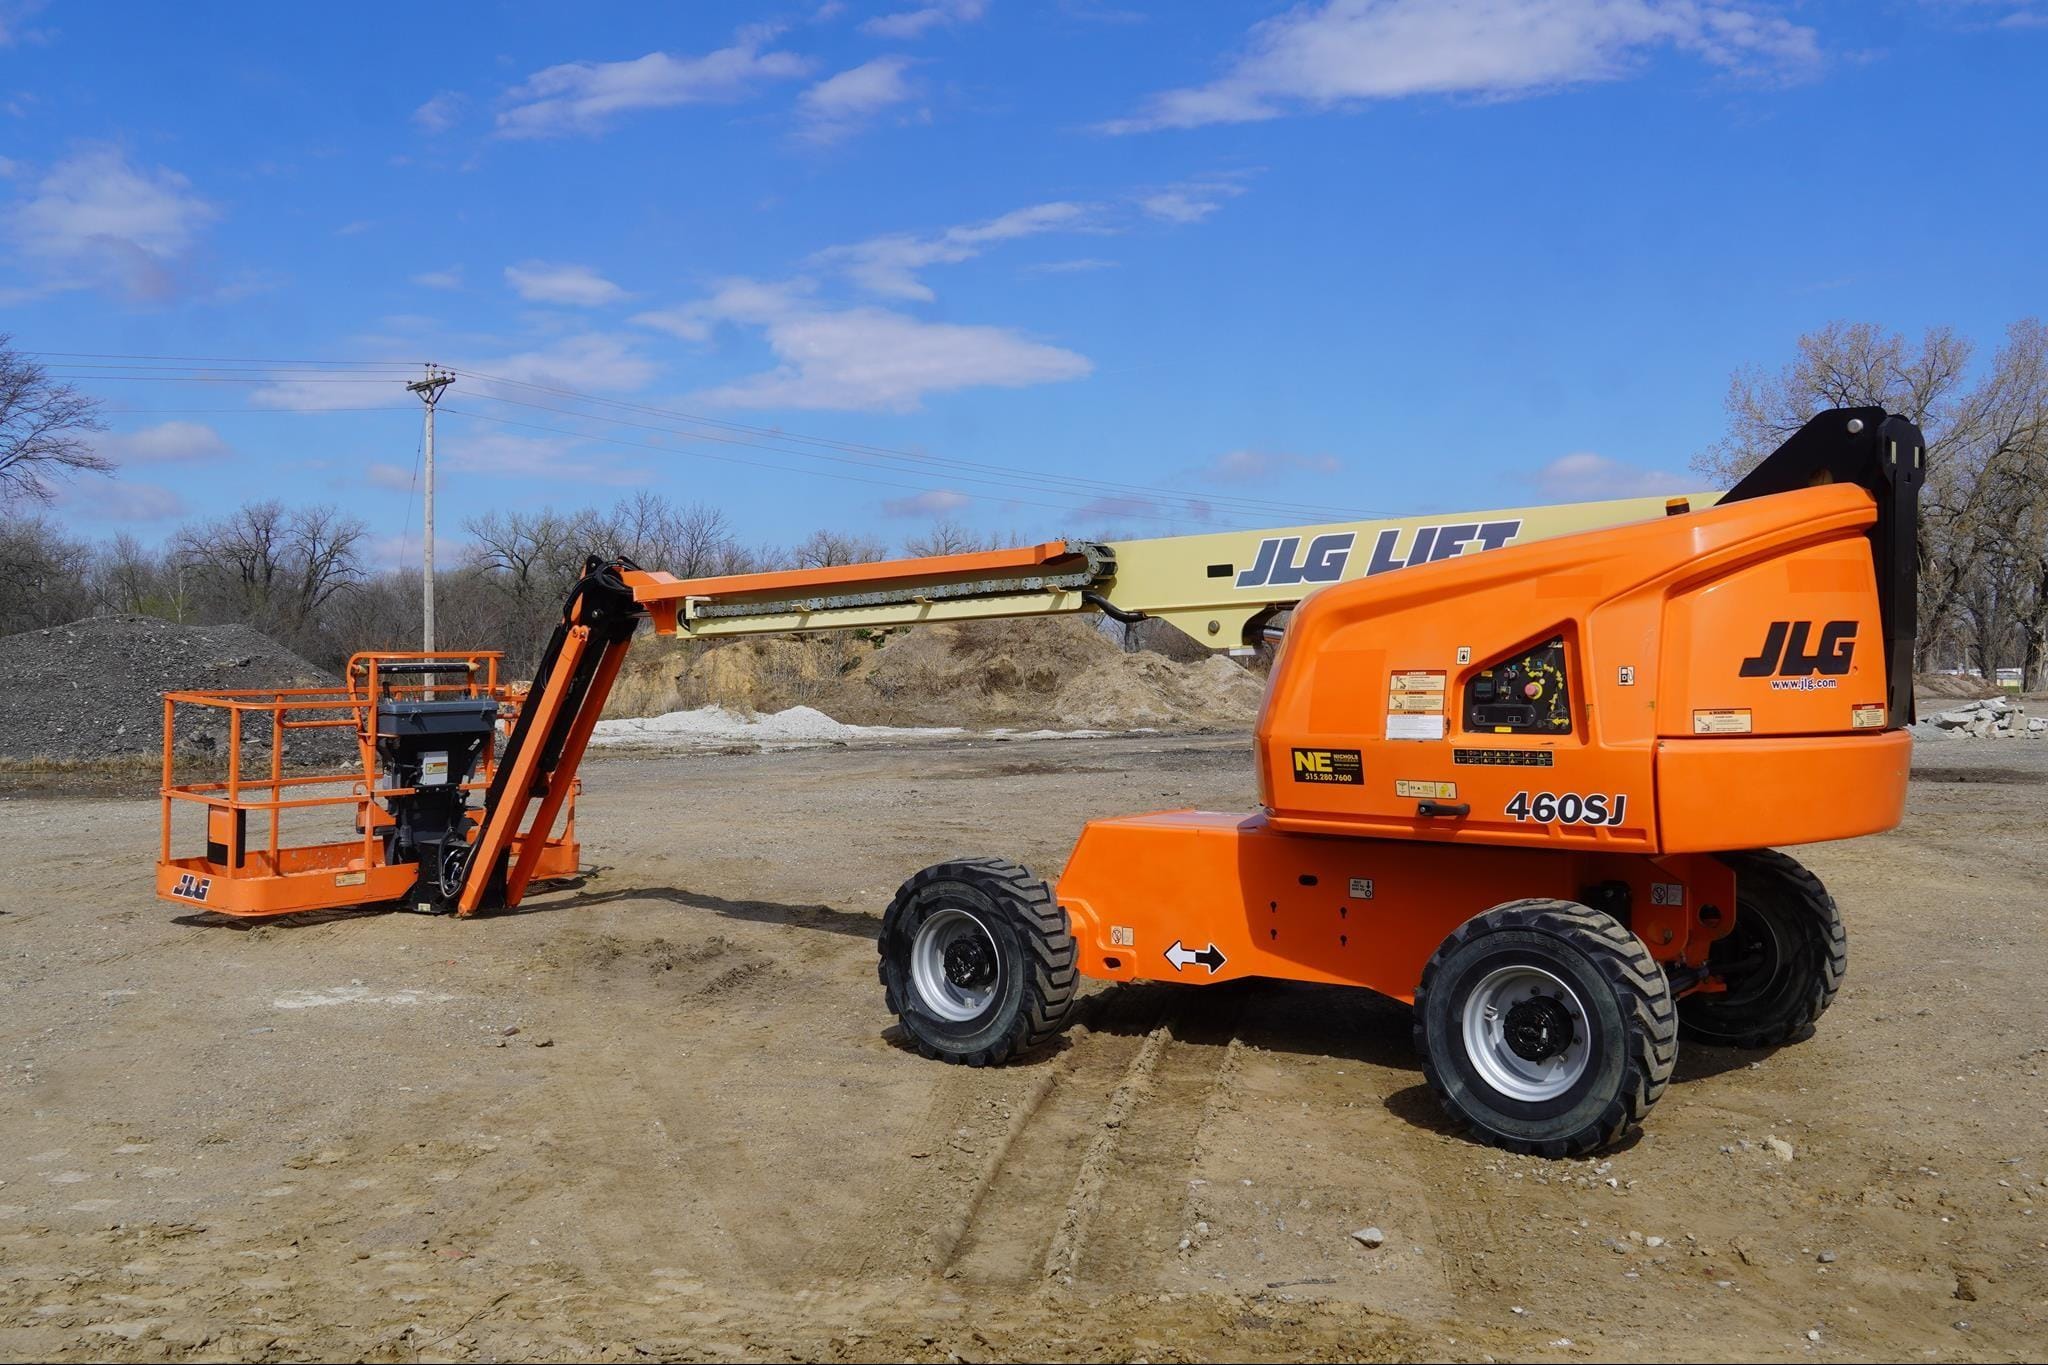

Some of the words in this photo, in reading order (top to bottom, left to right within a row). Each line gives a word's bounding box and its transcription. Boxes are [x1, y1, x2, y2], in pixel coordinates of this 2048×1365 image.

[1234, 531, 1358, 589] JLG
[1364, 518, 1524, 577] LIFT
[1738, 620, 1859, 677] JLG
[1771, 678, 1837, 691] www.jlg.com
[1294, 751, 1333, 771] NE
[1305, 772, 1352, 782] 515.280.7600
[1505, 791, 1627, 826] 460SJ
[172, 873, 212, 902] JLG
